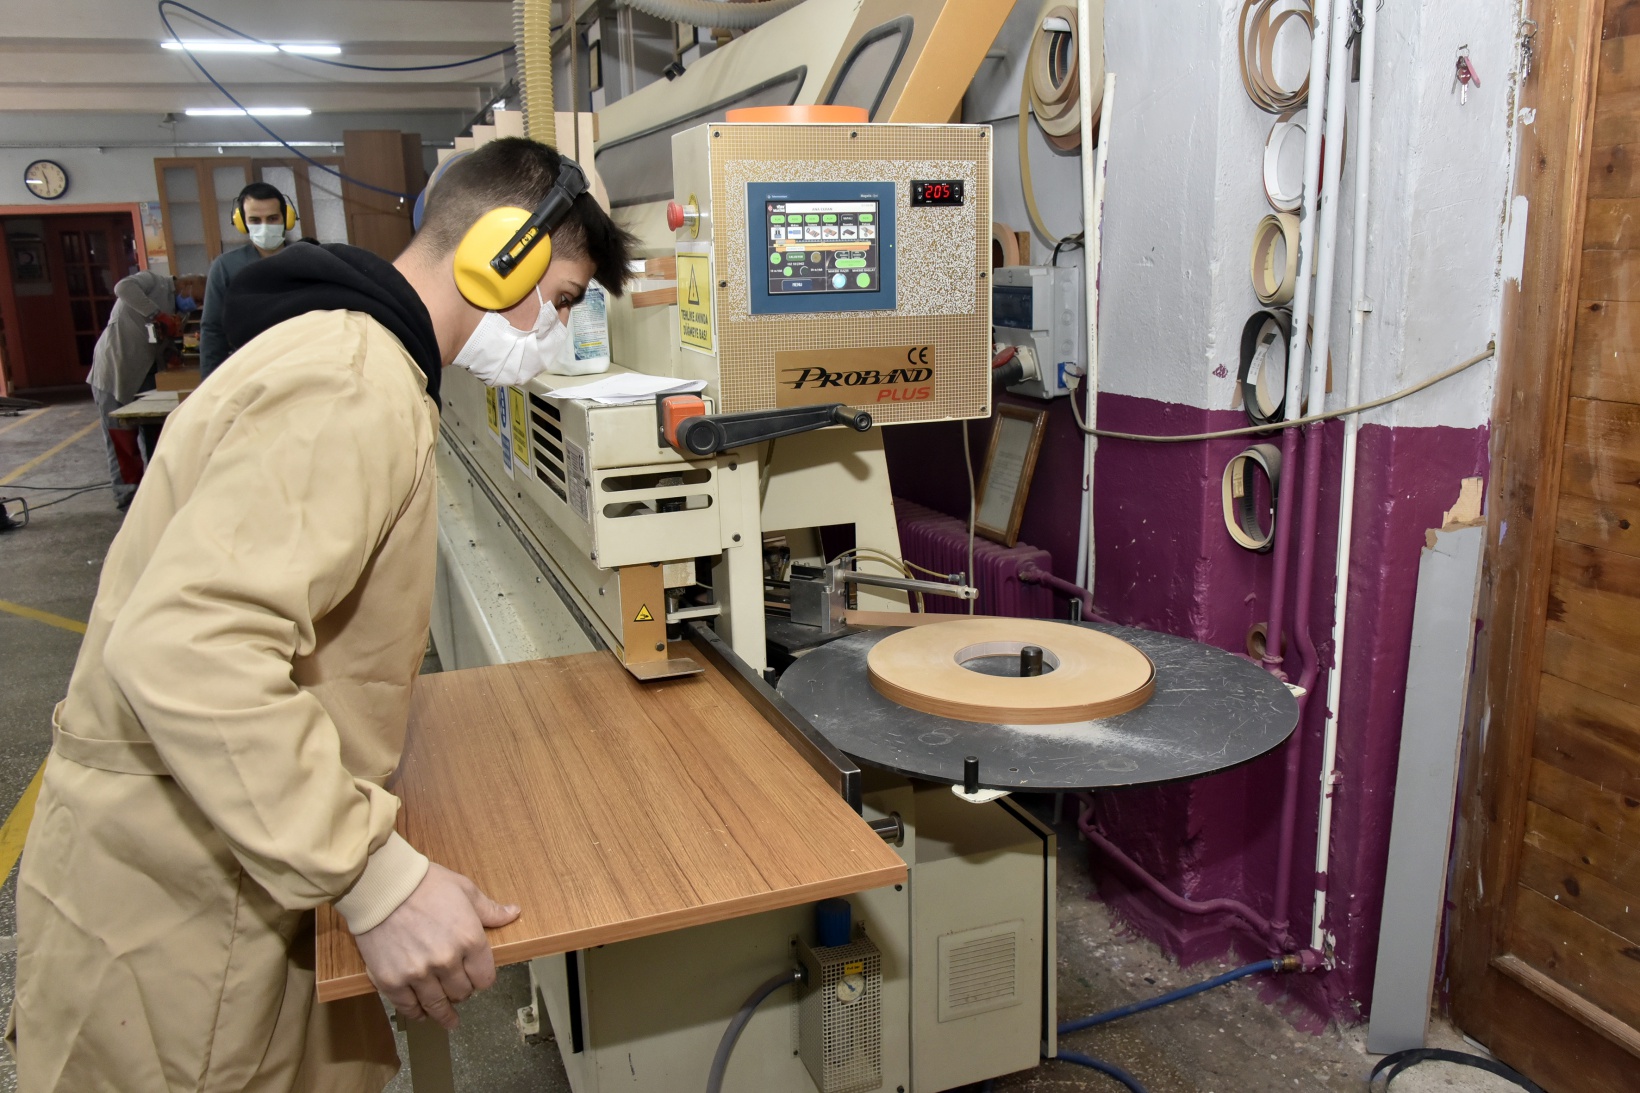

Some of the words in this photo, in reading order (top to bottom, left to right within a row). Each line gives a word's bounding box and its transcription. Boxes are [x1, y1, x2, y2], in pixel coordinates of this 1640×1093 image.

[925, 185, 950, 198] 205
[780, 366, 933, 389] PROBAND
[876, 387, 931, 402] PLUS
